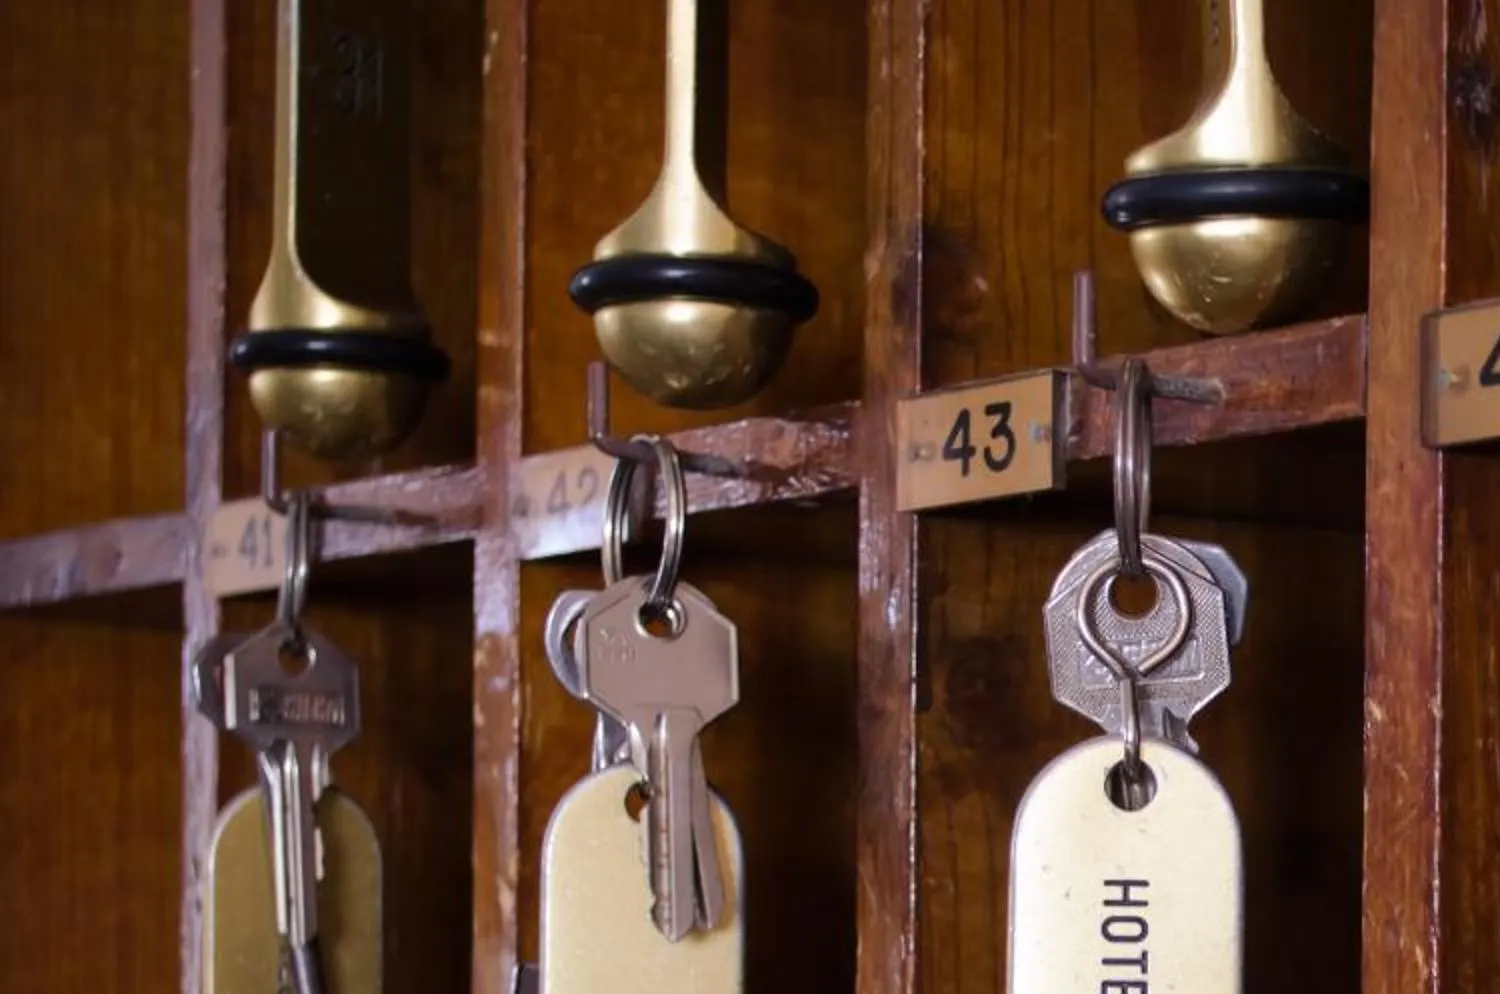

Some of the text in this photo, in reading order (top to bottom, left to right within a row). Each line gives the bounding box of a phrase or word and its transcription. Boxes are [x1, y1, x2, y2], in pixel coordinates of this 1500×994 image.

[942, 401, 1015, 477] 43
[546, 466, 599, 515] 42
[238, 513, 274, 569] 41
